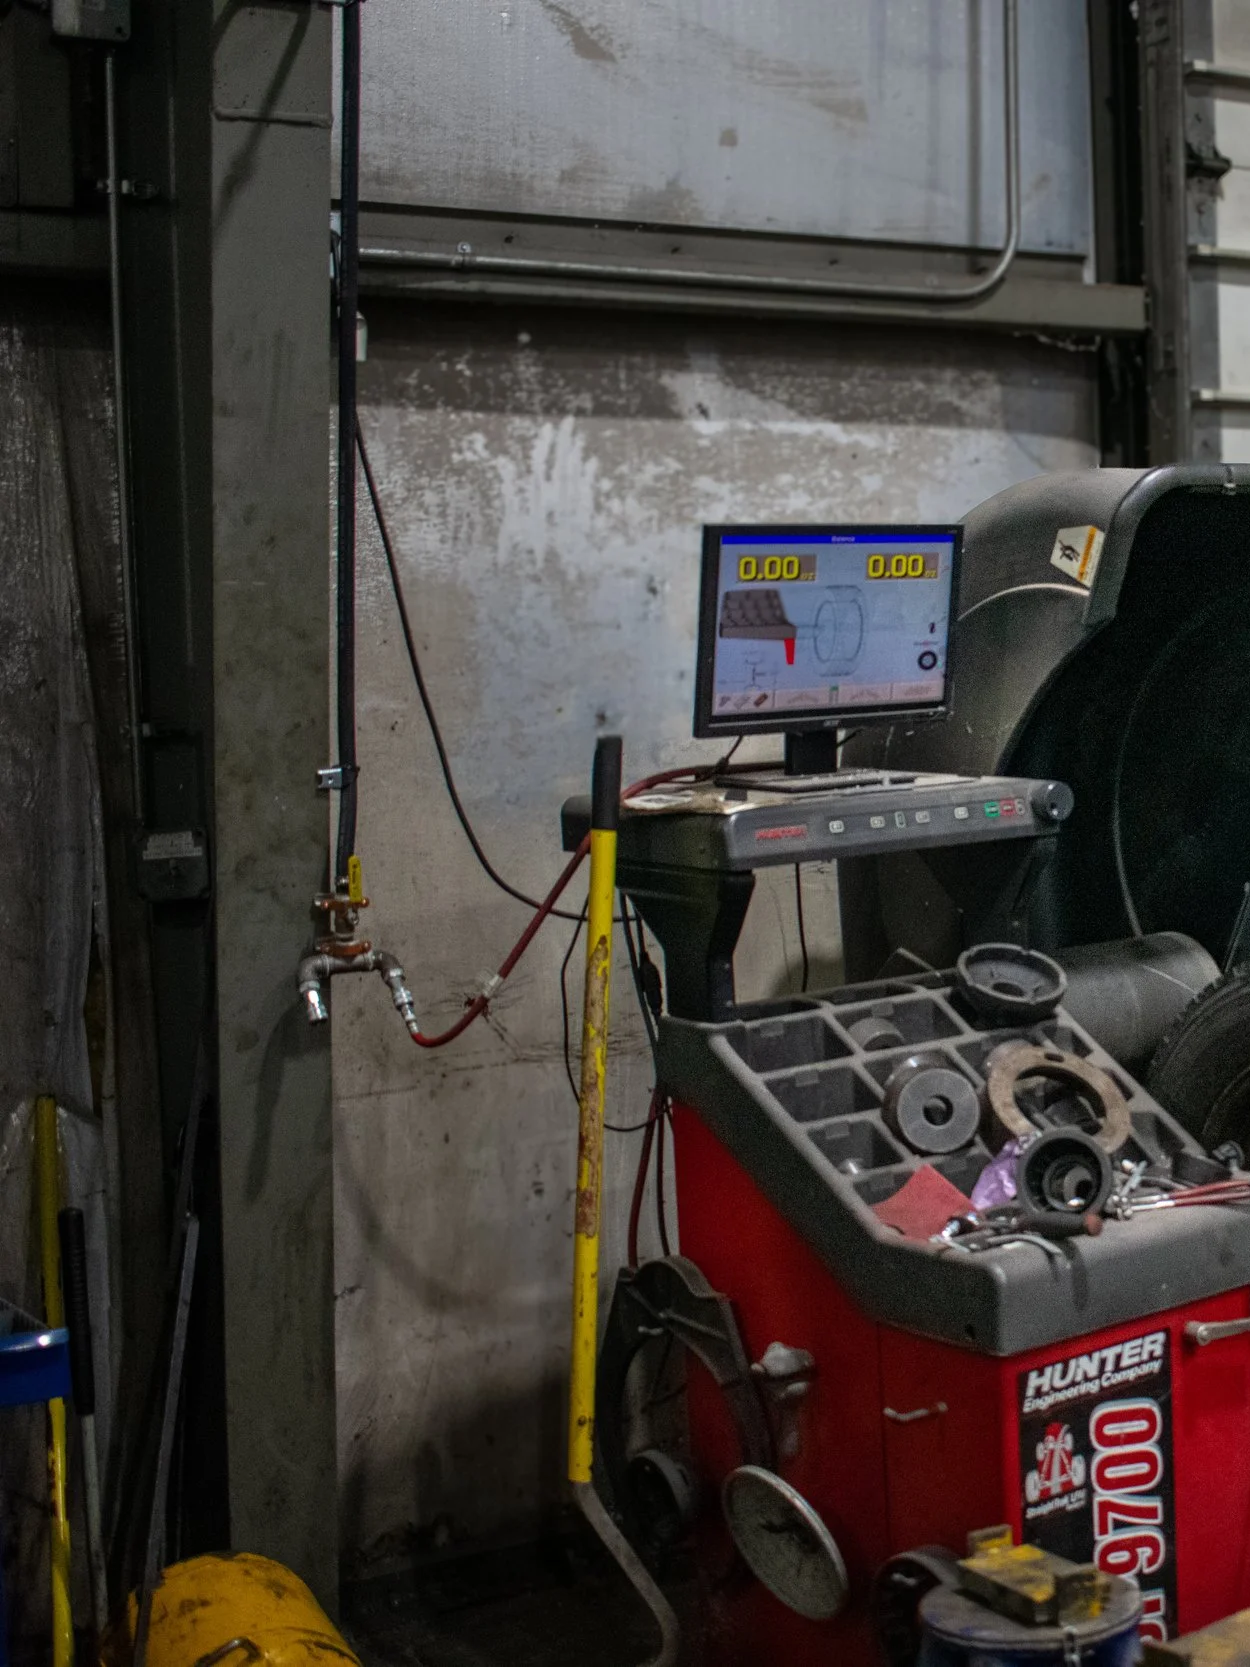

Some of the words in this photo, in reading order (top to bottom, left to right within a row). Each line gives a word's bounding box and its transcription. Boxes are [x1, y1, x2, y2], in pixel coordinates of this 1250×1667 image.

[739, 556, 800, 580] 0.00
[868, 554, 924, 578] 0.00
[1022, 1378, 1100, 1413] Engineering
[1101, 1358, 1163, 1388] Company
[1025, 1331, 1167, 1397] HUNTER
[1089, 1396, 1166, 1577] 9700
